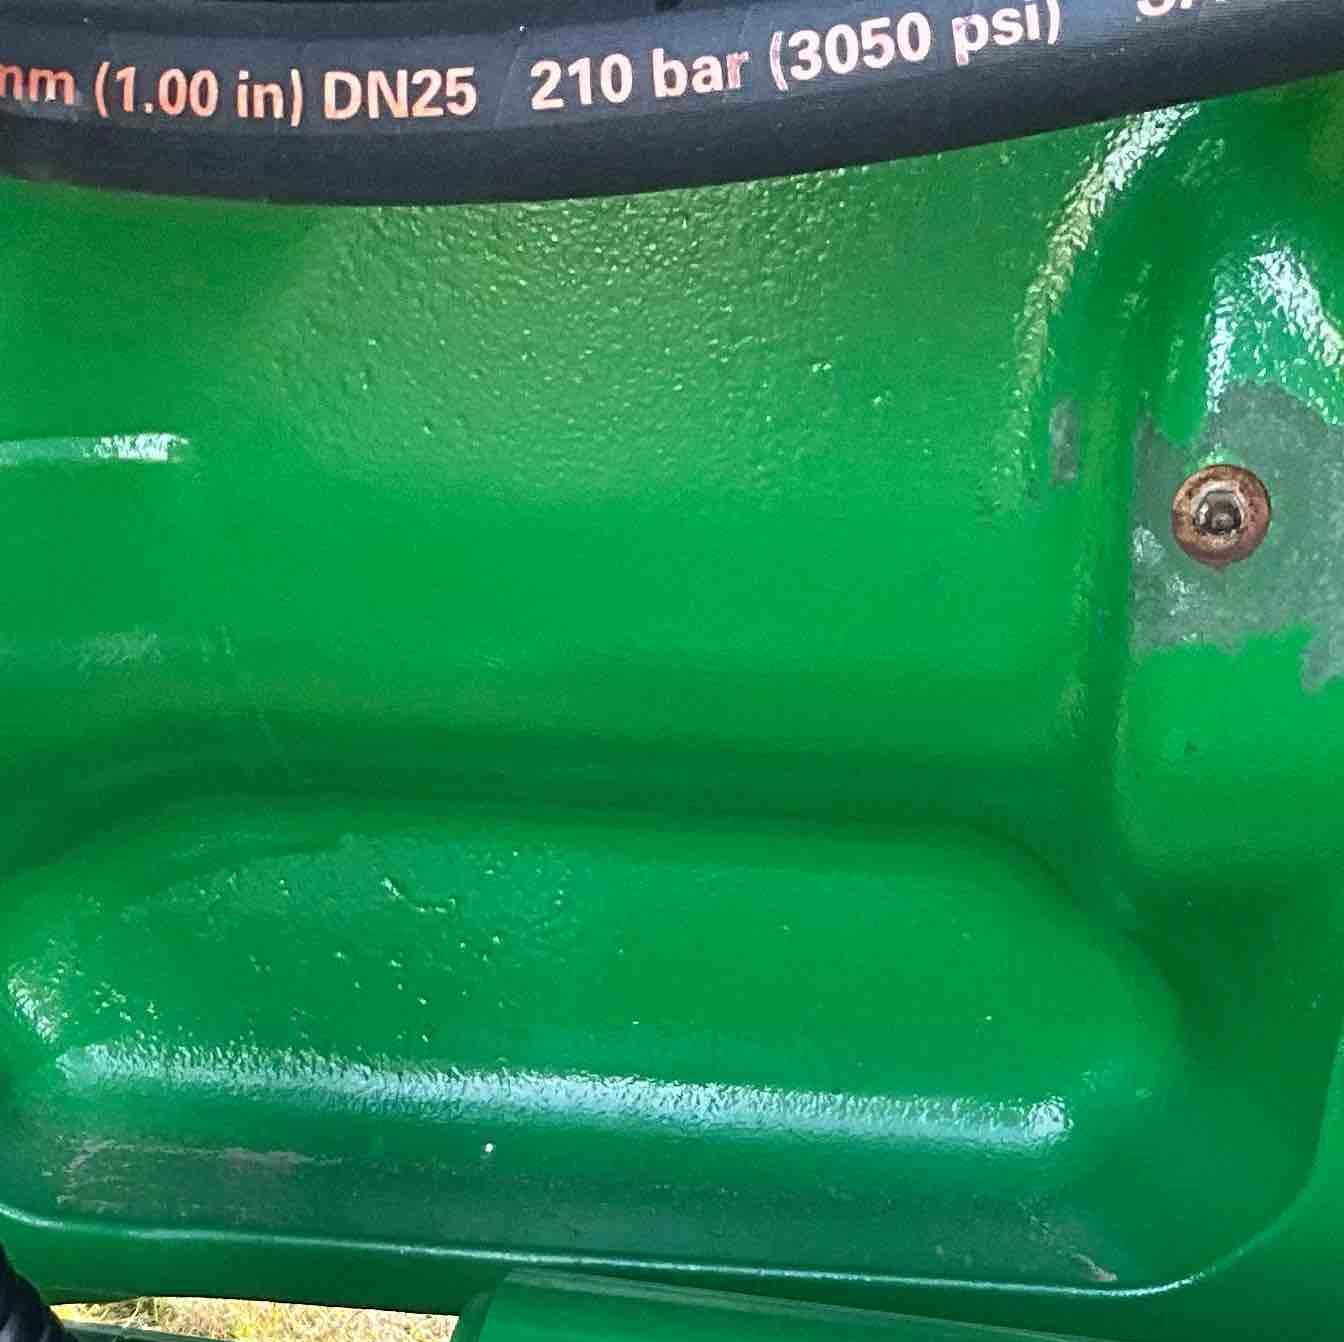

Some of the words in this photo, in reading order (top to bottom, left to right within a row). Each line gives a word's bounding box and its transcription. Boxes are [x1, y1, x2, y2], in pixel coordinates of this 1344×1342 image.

[94, 61, 219, 118] (1.00
[236, 68, 304, 128] in)
[323, 66, 478, 121] DN25
[530, 53, 634, 110] 210
[652, 48, 750, 97] bar
[769, 12, 932, 92] (3050
[952, 0, 1061, 65] psi)
